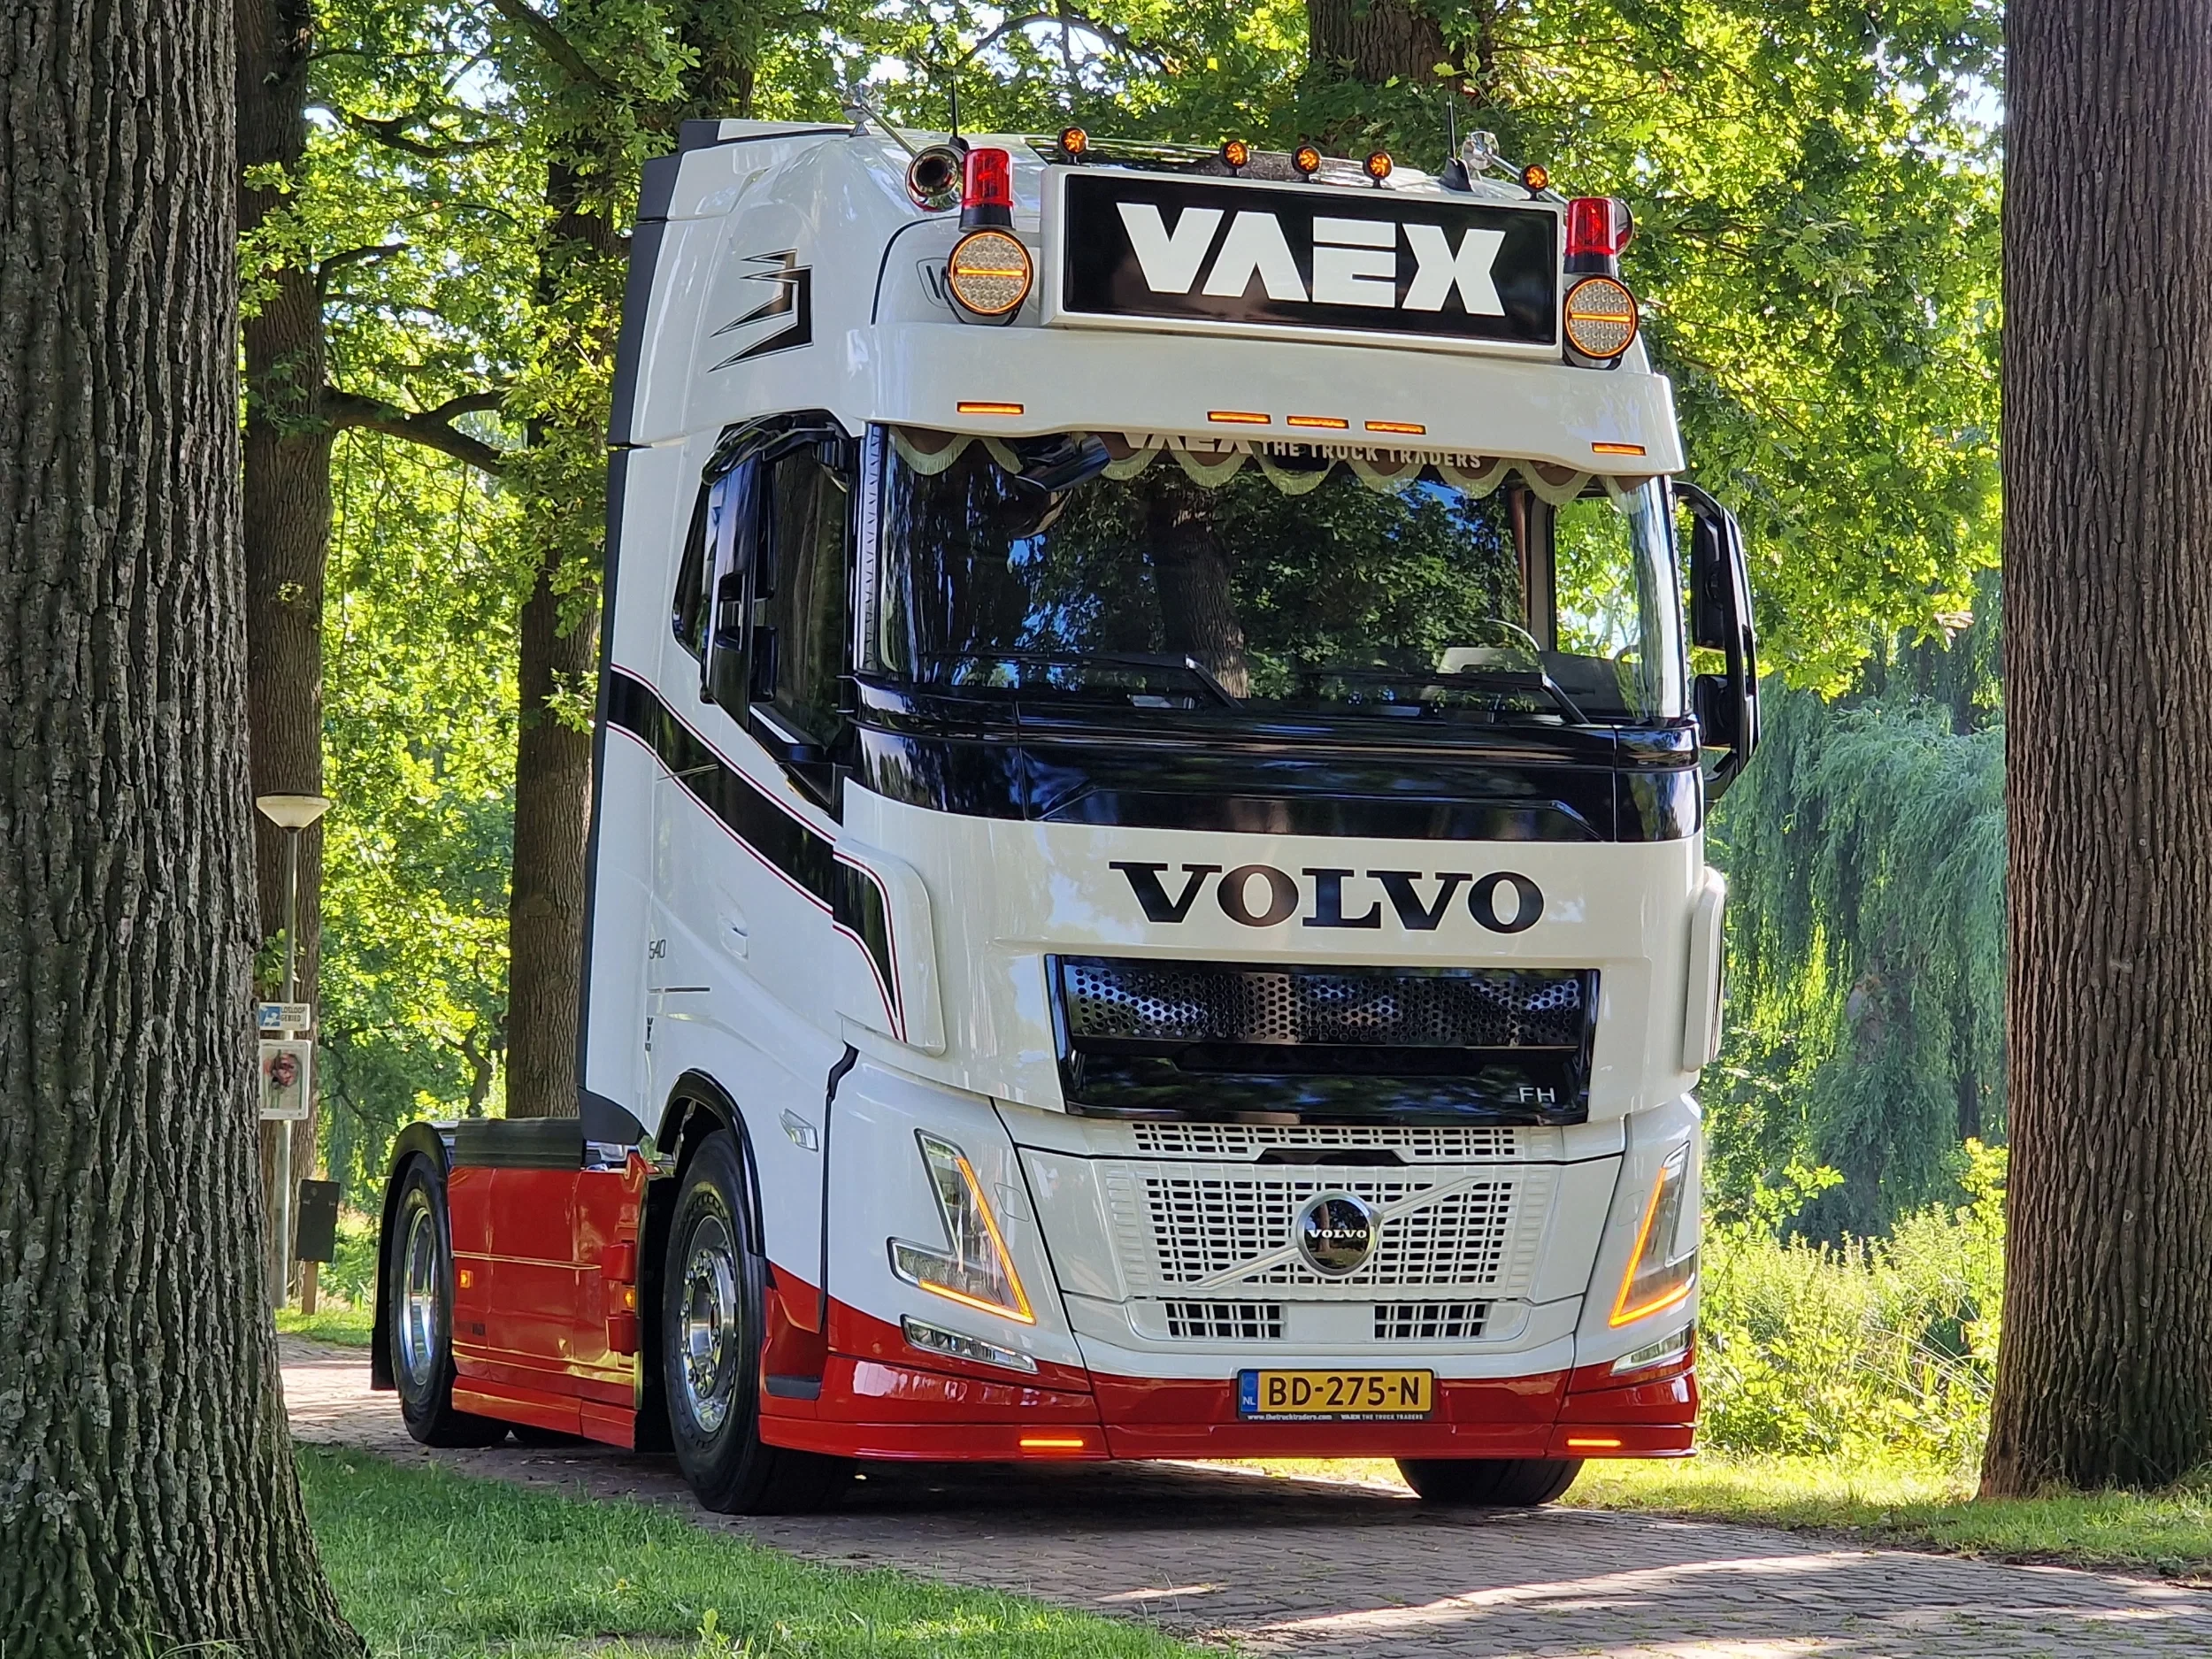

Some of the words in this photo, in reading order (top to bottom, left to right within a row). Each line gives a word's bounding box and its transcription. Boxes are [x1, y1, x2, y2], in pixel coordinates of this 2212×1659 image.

[1117, 203, 1505, 316] VAEX
[1261, 442, 1300, 457] THE
[1310, 443, 1379, 461] TRUCK
[1388, 449, 1481, 468] TRADERS
[1109, 861, 1544, 933] VOLVO
[649, 939, 666, 959] 540
[1519, 1087, 1555, 1102] FH
[1308, 1229, 1368, 1239] VOLVO
[1242, 1396, 1256, 1406] NL
[1269, 1377, 1419, 1406] BD-275-N
